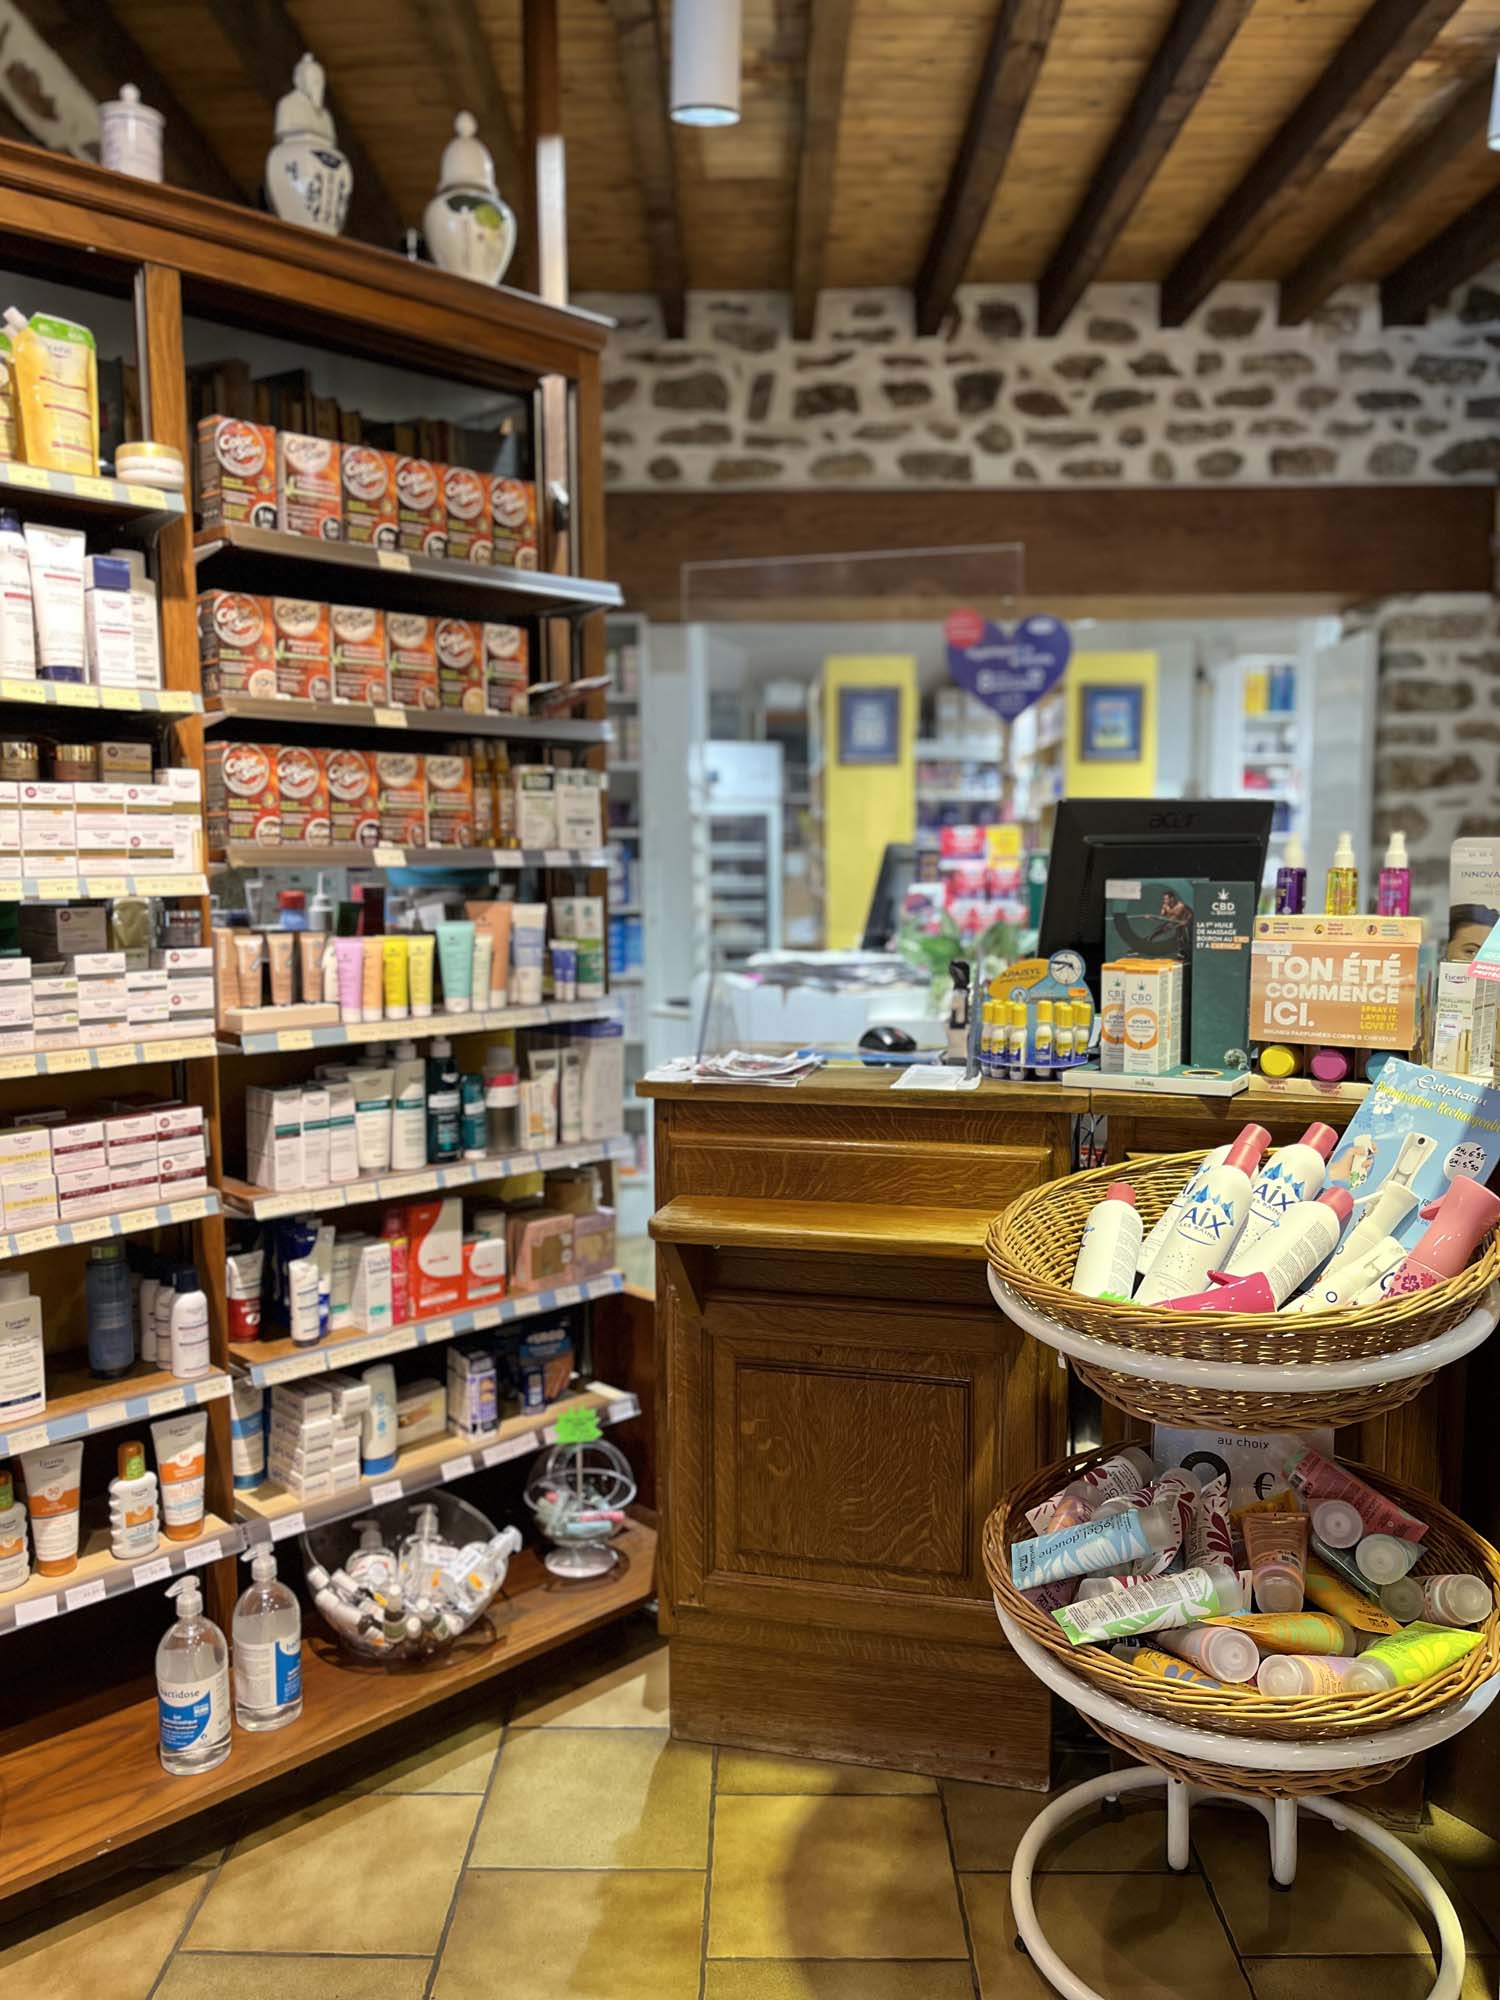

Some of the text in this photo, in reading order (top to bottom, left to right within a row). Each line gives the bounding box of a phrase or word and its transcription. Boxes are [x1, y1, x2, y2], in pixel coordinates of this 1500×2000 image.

[1148, 812, 1199, 829] acer
[1211, 902, 1235, 911] CBD
[1266, 952, 1401, 985] TON ÉTÉ
[1445, 973, 1471, 981] Eucerin
[1131, 993, 1152, 1001] CBD
[1265, 982, 1400, 1005] COMMENCE
[1264, 1000, 1315, 1027] ICI.
[1361, 1006, 1386, 1014] SPRAY
[1360, 1021, 1383, 1030] LOVE
[1416, 1075, 1488, 1107] Estipharm
[1217, 1437, 1270, 1449] au choix
[1038, 1533, 1081, 1559] douche
